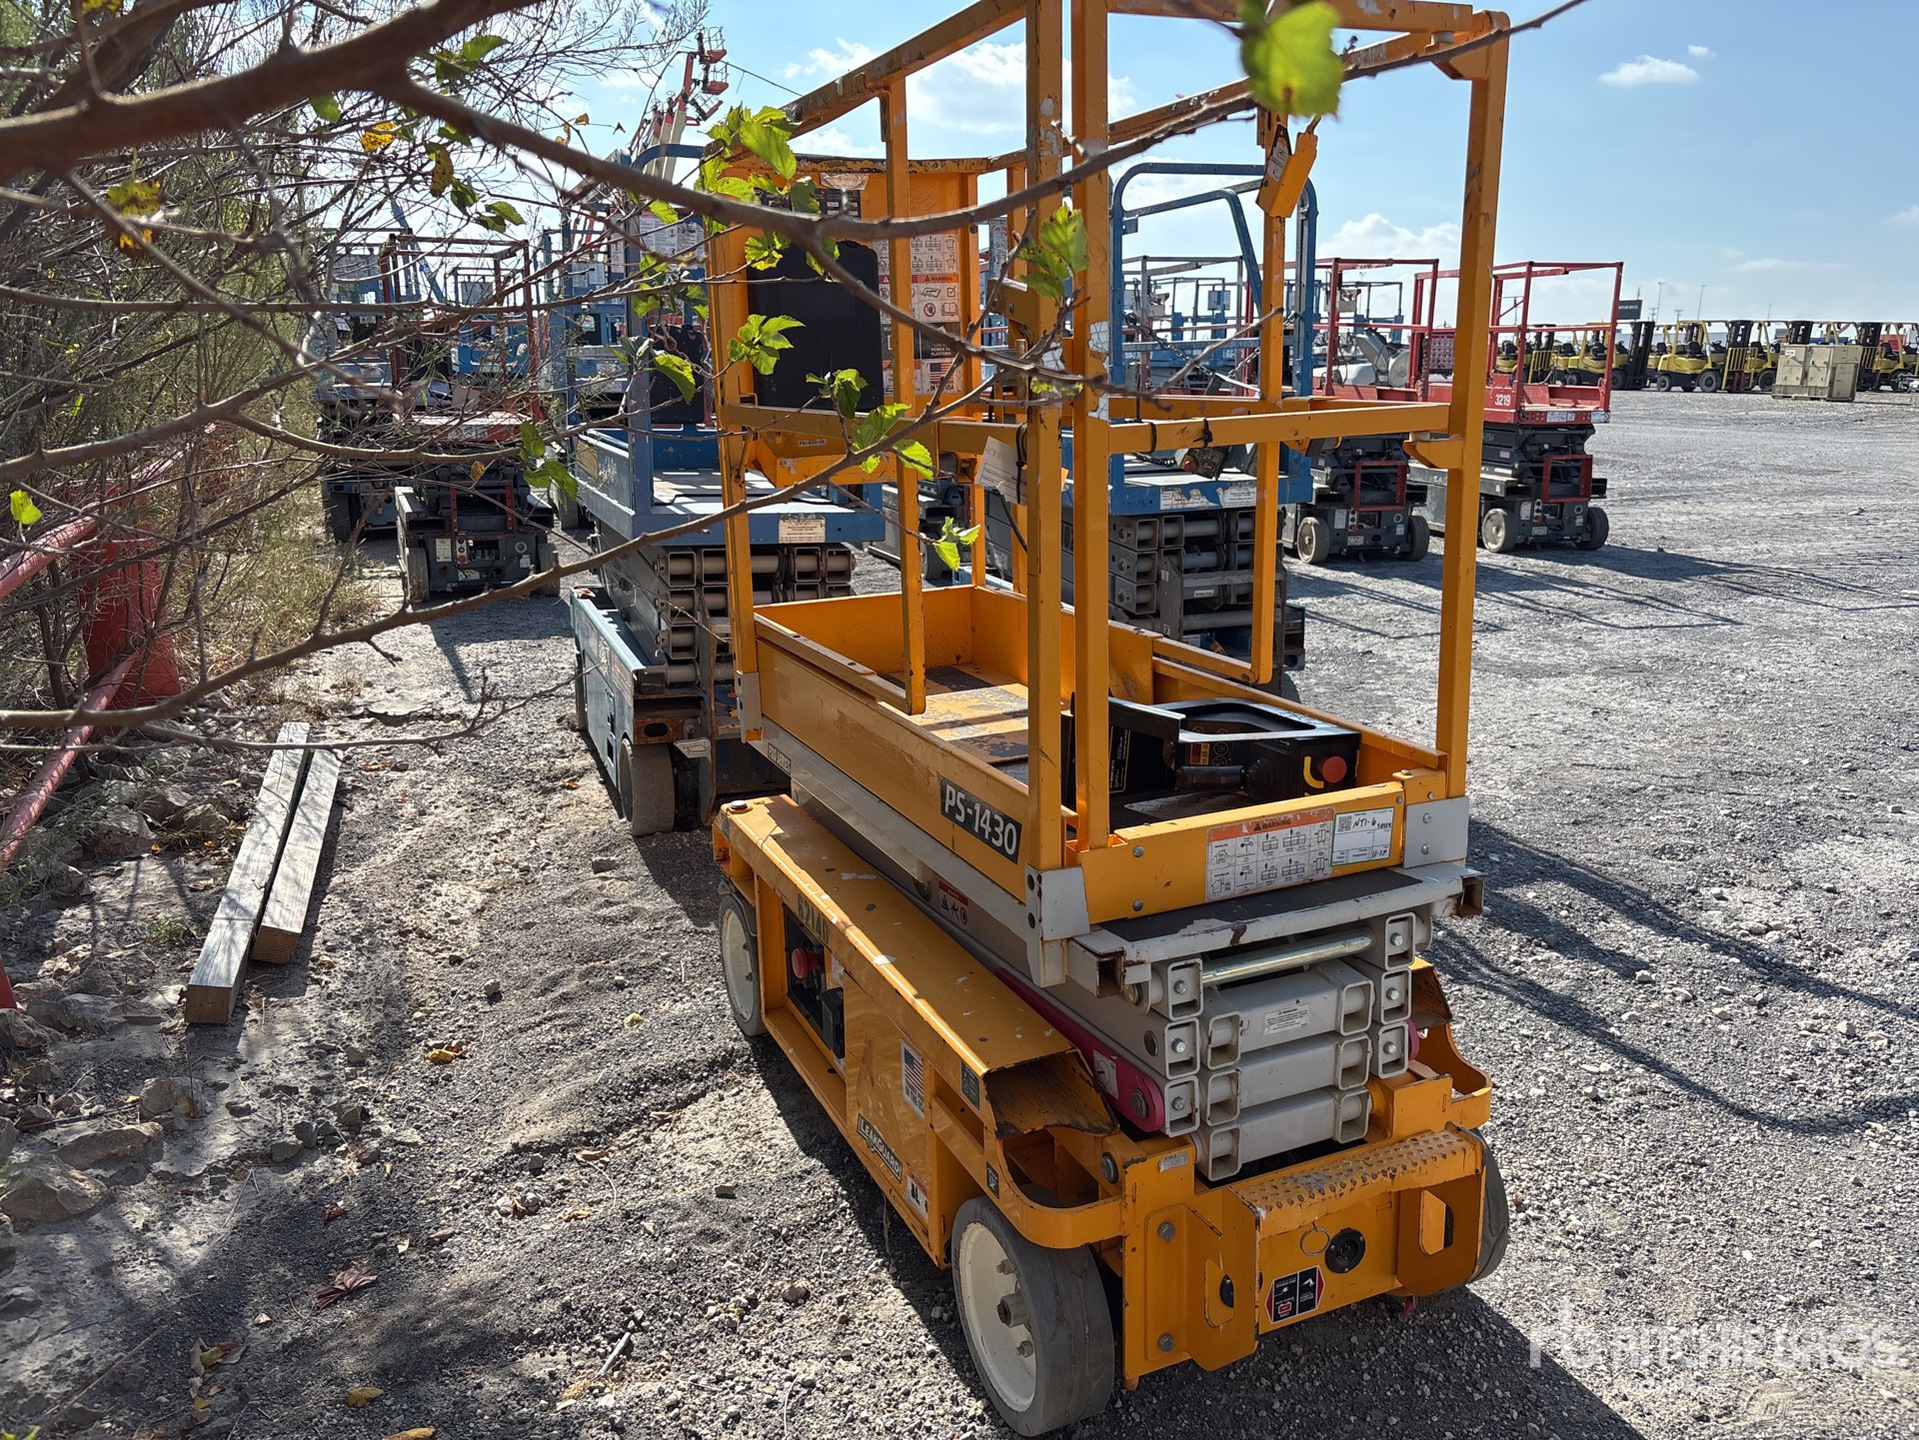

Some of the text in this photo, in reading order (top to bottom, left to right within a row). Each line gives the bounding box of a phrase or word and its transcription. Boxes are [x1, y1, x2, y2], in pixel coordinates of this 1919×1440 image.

[1494, 394, 1511, 406] 3219
[945, 784, 1017, 855] PS-1430
[1261, 819, 1291, 830] WARNING
[860, 1117, 901, 1178] LEAKGUARD
